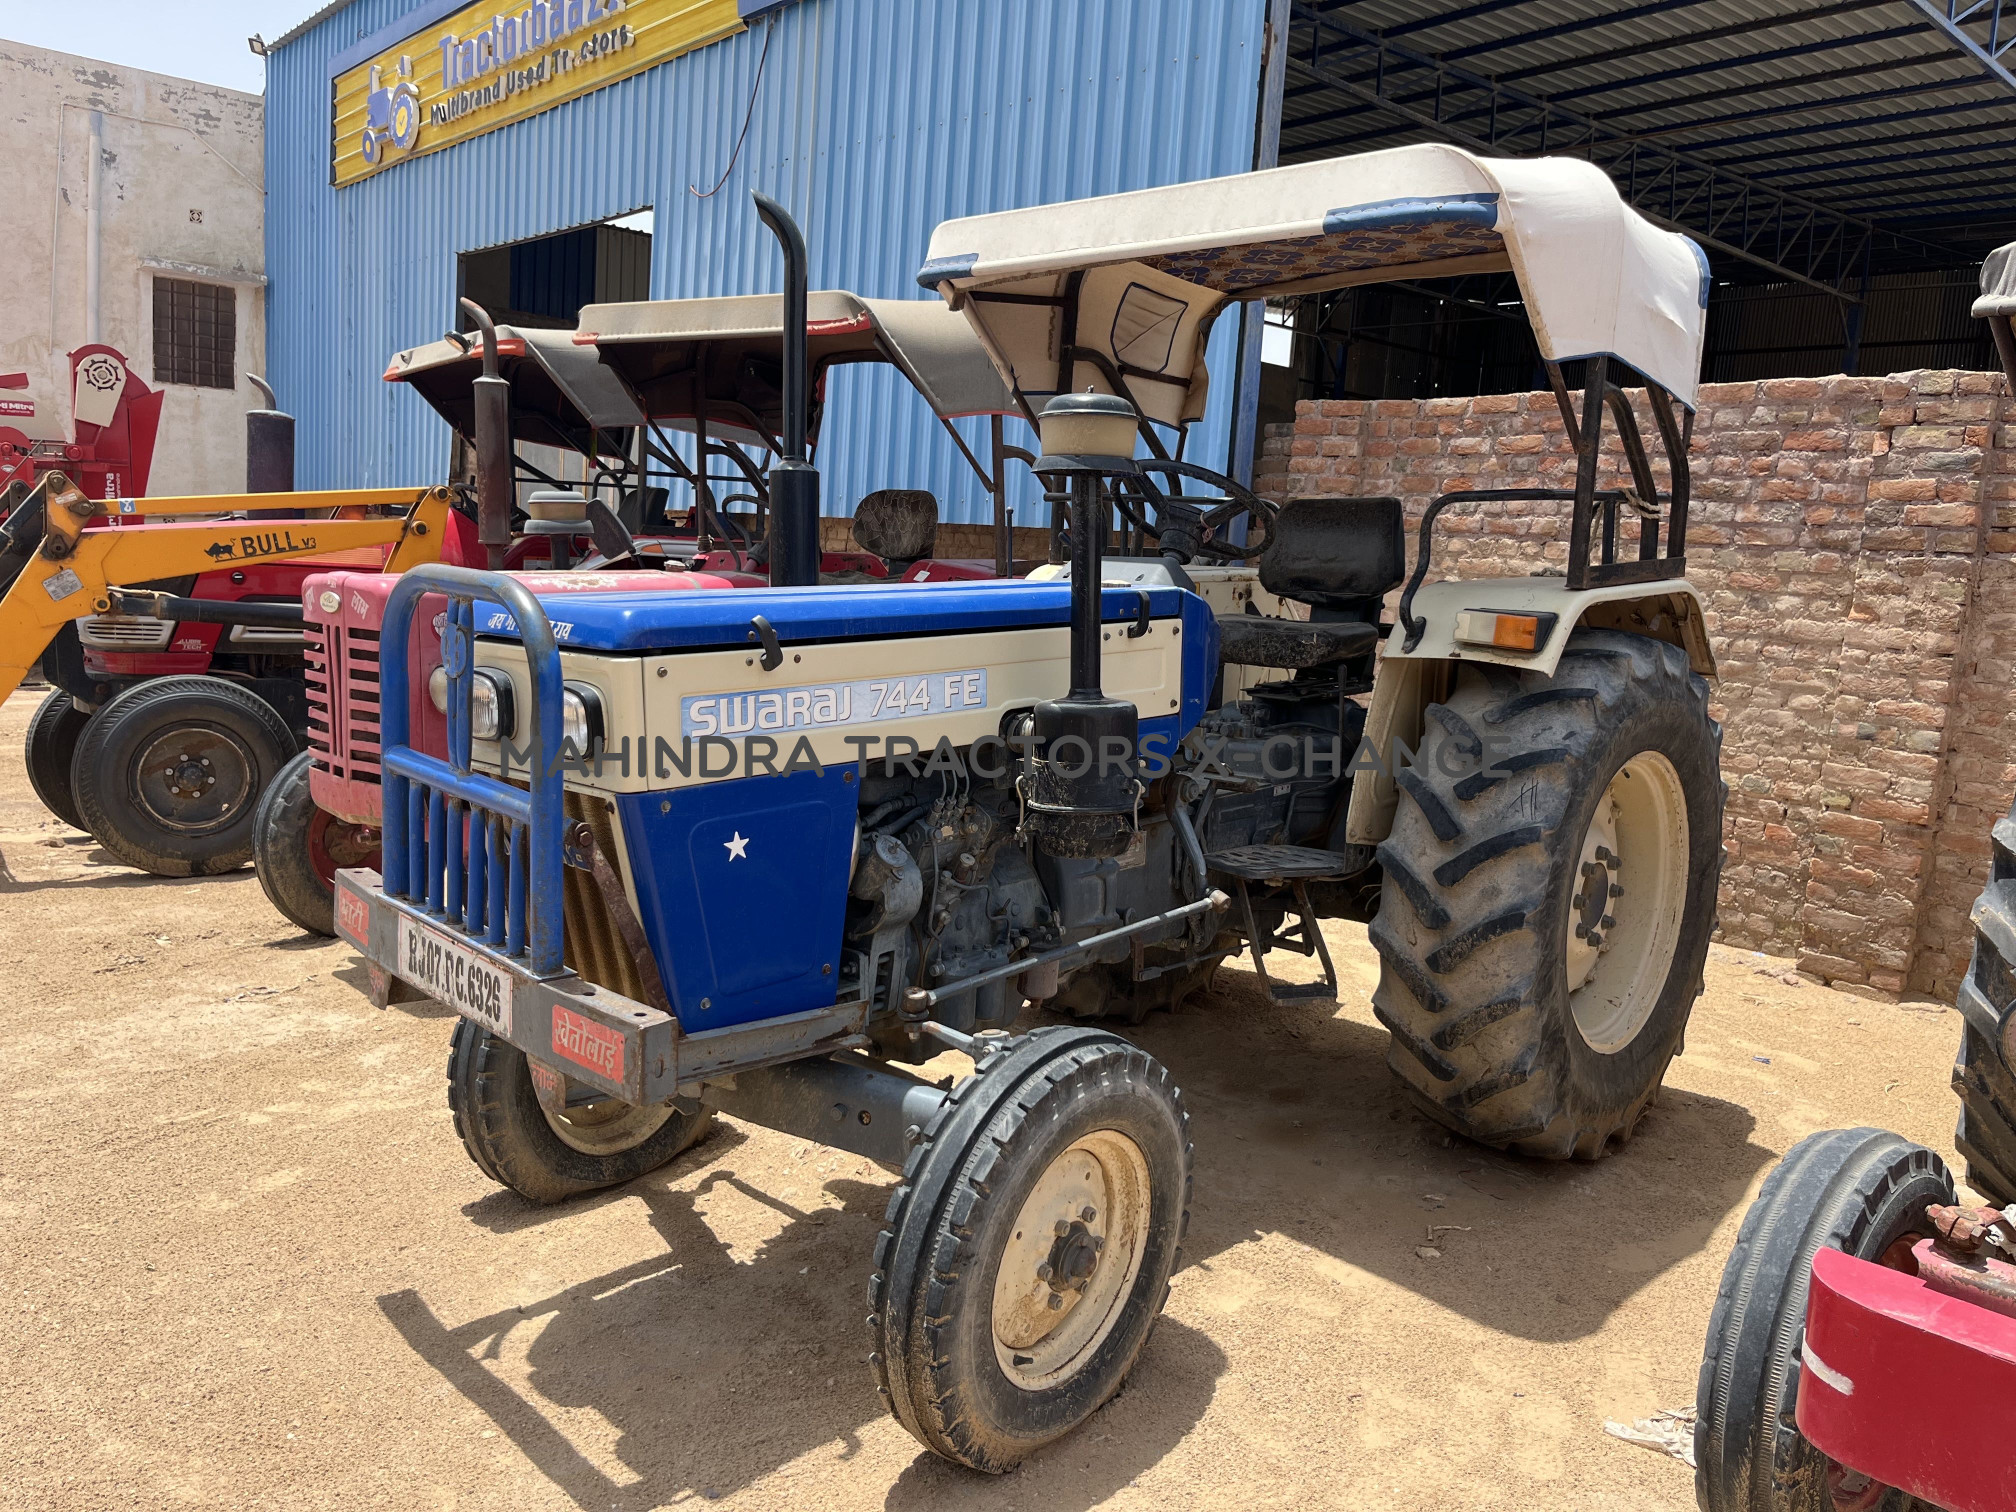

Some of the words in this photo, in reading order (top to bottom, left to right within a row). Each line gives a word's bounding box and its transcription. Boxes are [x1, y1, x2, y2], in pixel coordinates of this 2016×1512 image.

[506, 56, 549, 94] Used
[240, 531, 299, 557] BULL
[487, 613, 507, 629] जय
[869, 678, 931, 718] 744
[943, 673, 982, 709] FE
